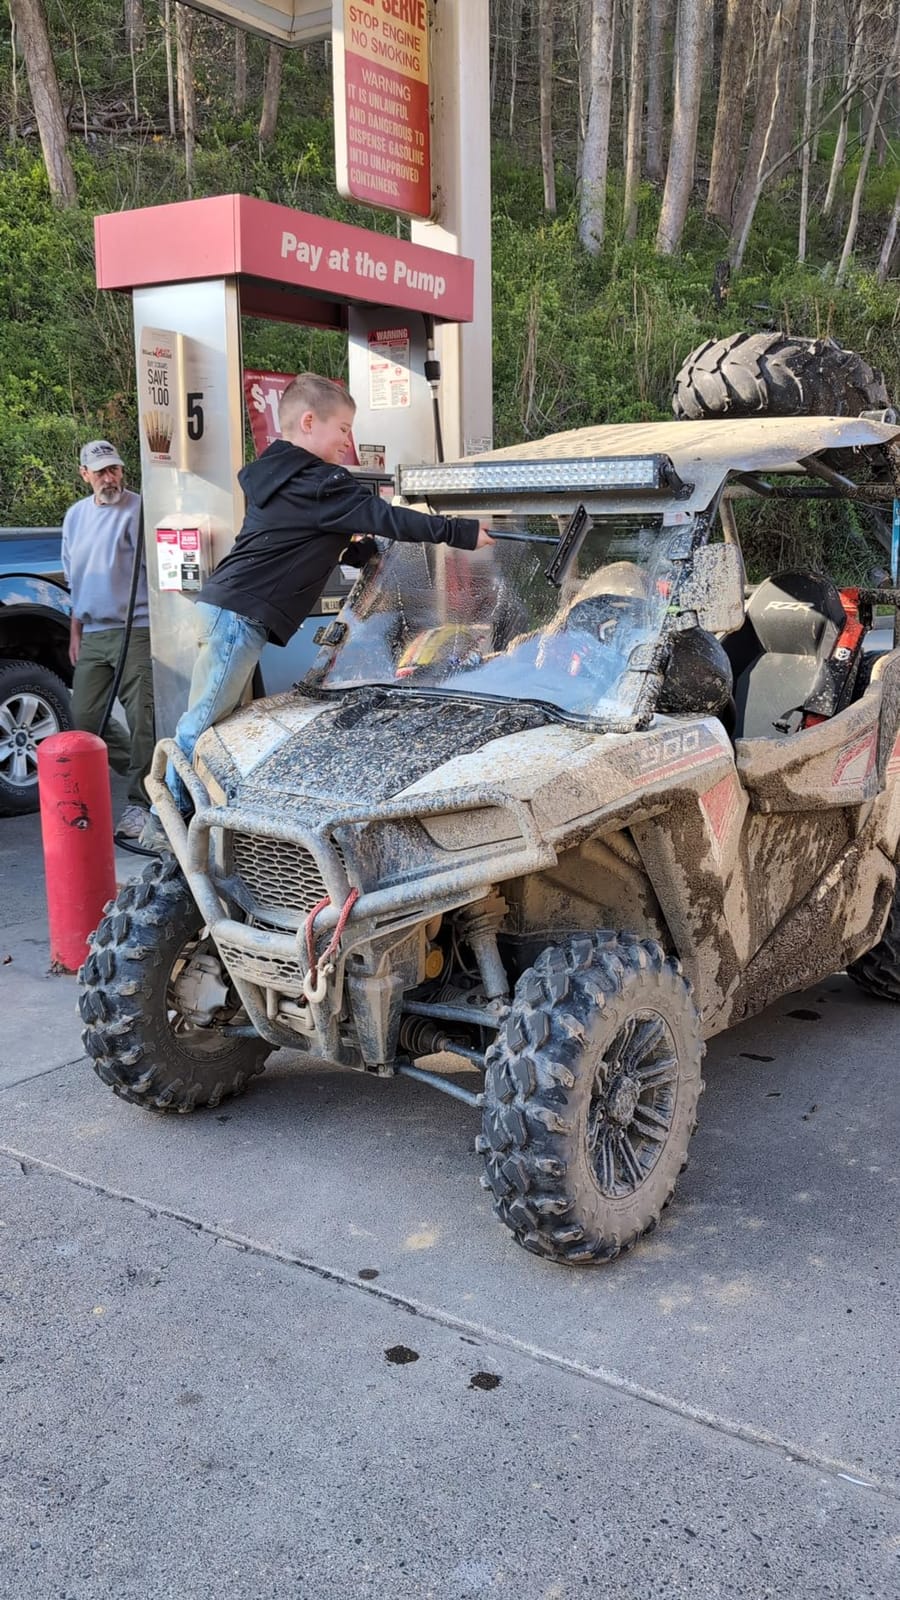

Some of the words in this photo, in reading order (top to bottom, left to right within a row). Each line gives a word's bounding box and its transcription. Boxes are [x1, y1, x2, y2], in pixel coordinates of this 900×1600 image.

[349, 5, 379, 31] STOP
[382, 21, 421, 53] ENGINE
[351, 27, 368, 49] NO
[370, 36, 421, 72] SMOKING
[347, 83, 356, 101] IT
[358, 87, 367, 105] IS
[368, 91, 409, 121] UNLAWFUL
[361, 67, 411, 102] WARNING
[349, 104, 366, 125] AND
[368, 112, 413, 143] DANGEROUS
[414, 129, 425, 147] TO
[349, 125, 386, 153] DISPENSE
[388, 140, 425, 166] GASOLINE
[350, 145, 369, 167] INTO
[370, 153, 420, 184] UNAPPROVED
[280, 231, 323, 272] Pay
[328, 248, 350, 273] at
[355, 251, 388, 282] the
[393, 260, 446, 300] Pump
[376, 328, 408, 341] WARNING
[147, 368, 169, 387] SAVE
[186, 392, 204, 441] 5
[764, 601, 815, 611] RZR
[640, 728, 700, 769] 900
